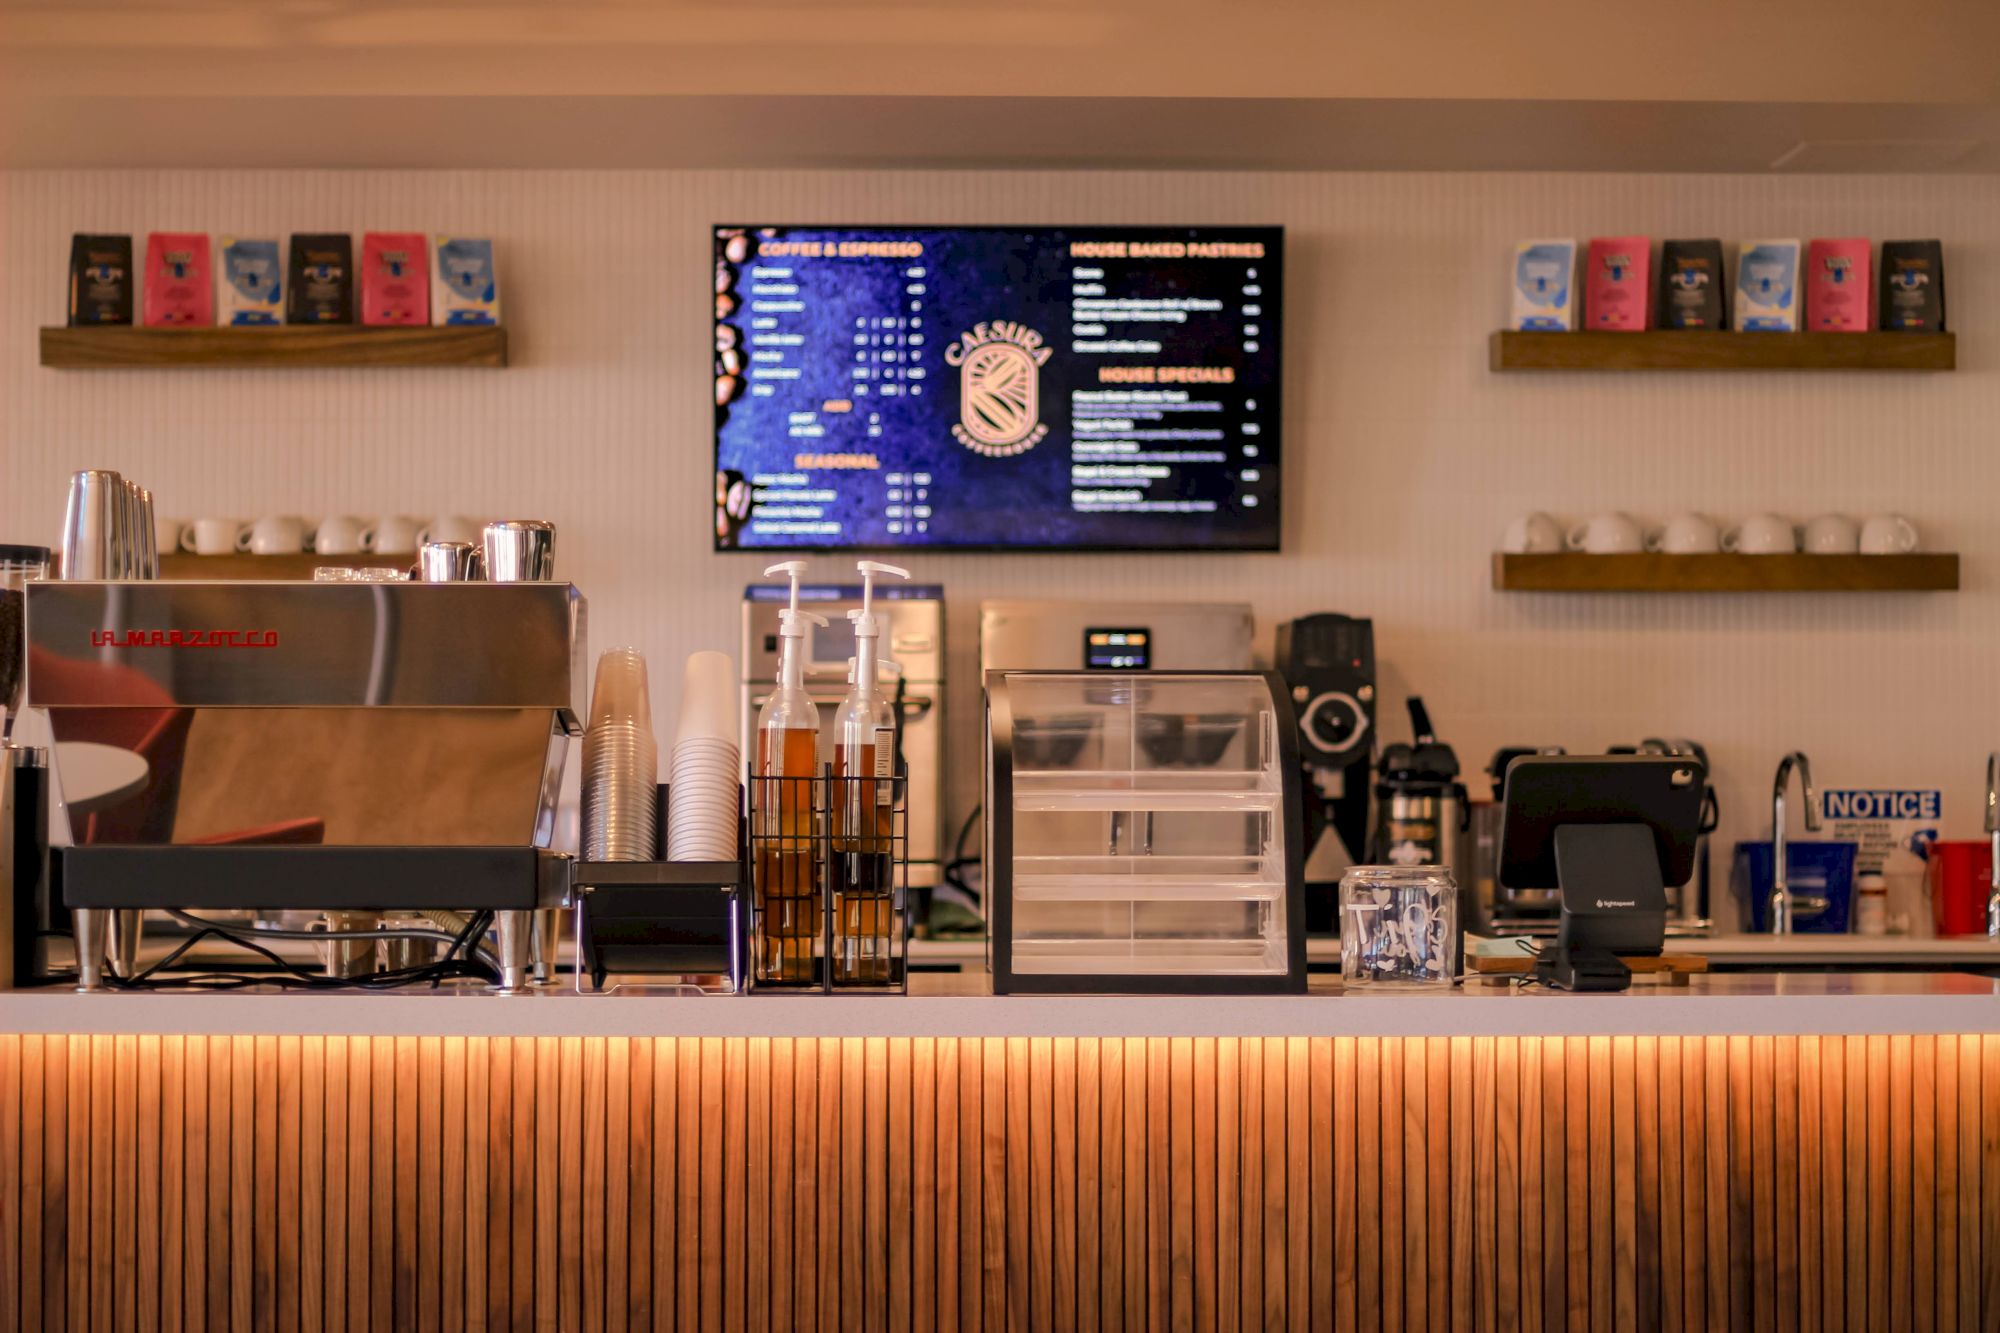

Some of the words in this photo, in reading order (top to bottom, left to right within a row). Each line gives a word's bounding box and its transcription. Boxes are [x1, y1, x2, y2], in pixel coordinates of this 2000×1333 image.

[758, 241, 821, 258] COFFEE
[839, 241, 923, 258] ESPRESSO
[1070, 242, 1128, 258] HOUSE
[1129, 242, 1186, 258] BAKED
[1187, 242, 1265, 258] PASTRIES
[944, 319, 1054, 367] CAESURA
[1099, 366, 1155, 383] HOUSE
[1157, 366, 1235, 383] SPECIALS
[794, 453, 880, 470] SEASONAL
[1827, 792, 1937, 818] NOTICE
